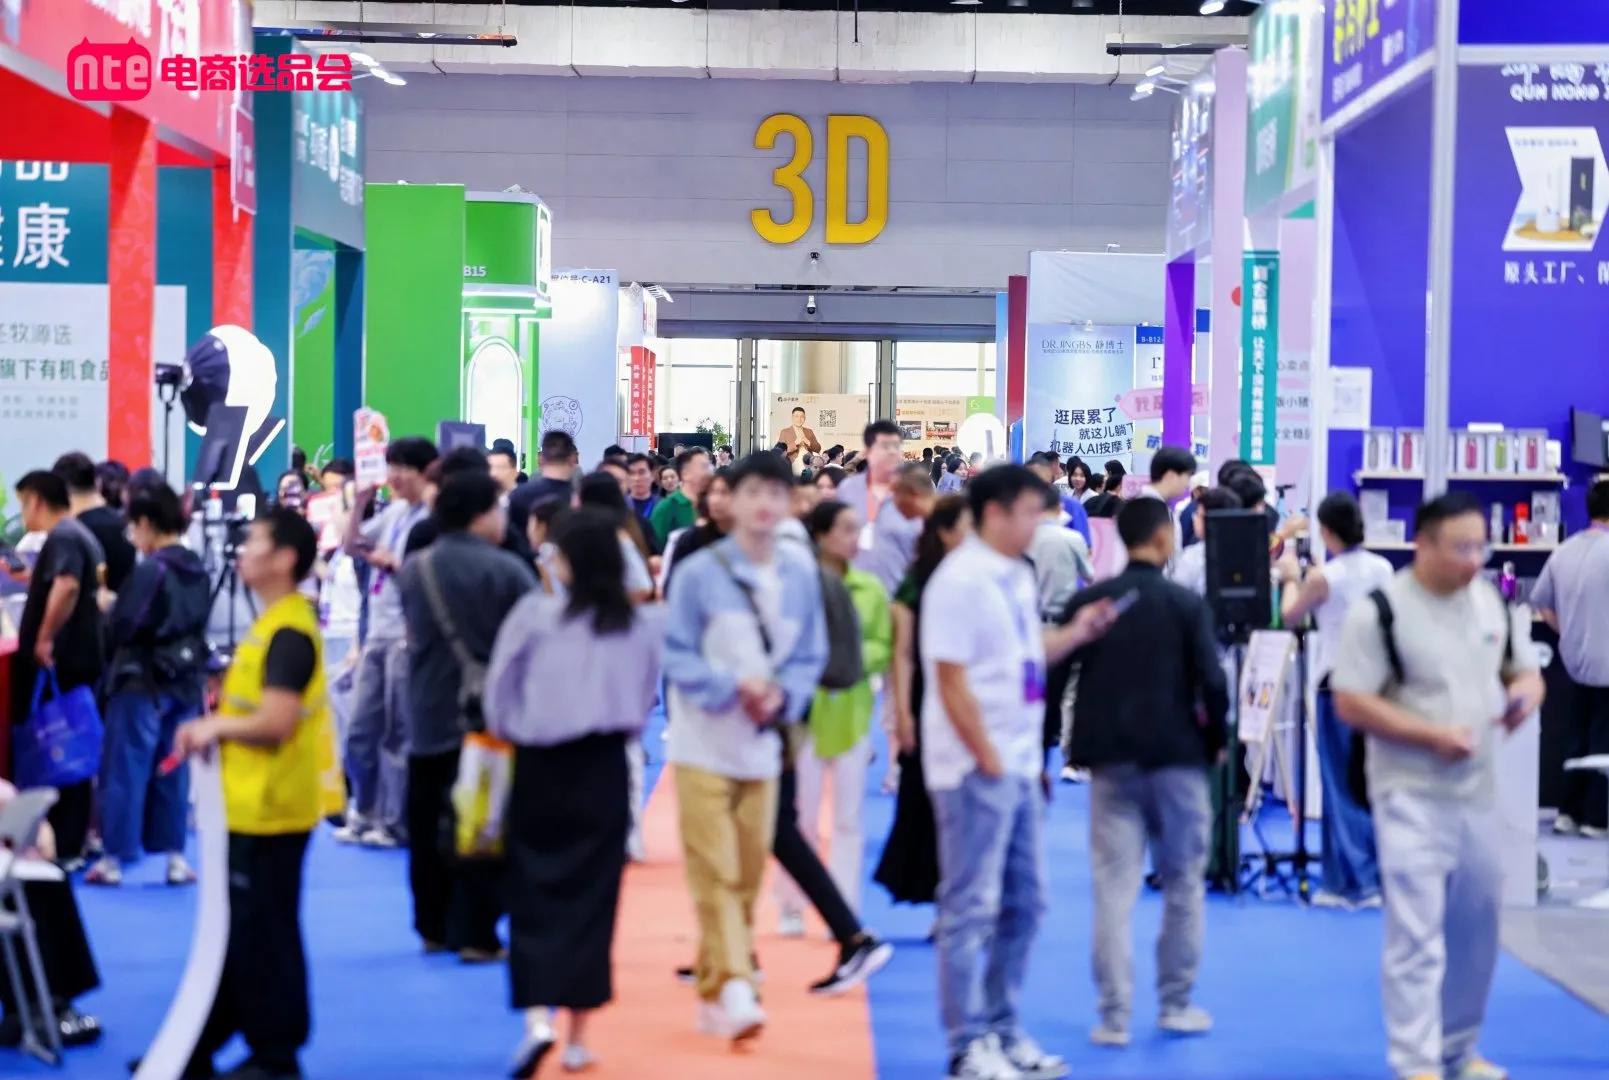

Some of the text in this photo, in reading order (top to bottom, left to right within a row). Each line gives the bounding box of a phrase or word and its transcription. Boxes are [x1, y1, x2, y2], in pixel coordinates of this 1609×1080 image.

[751, 112, 890, 245] 3D
[1095, 339, 1125, 350] 静博士
[632, 402, 640, 424] 小红书
[1054, 407, 1116, 426] 逛展累了
[1050, 440, 1123, 455] 机器人AI按摩
